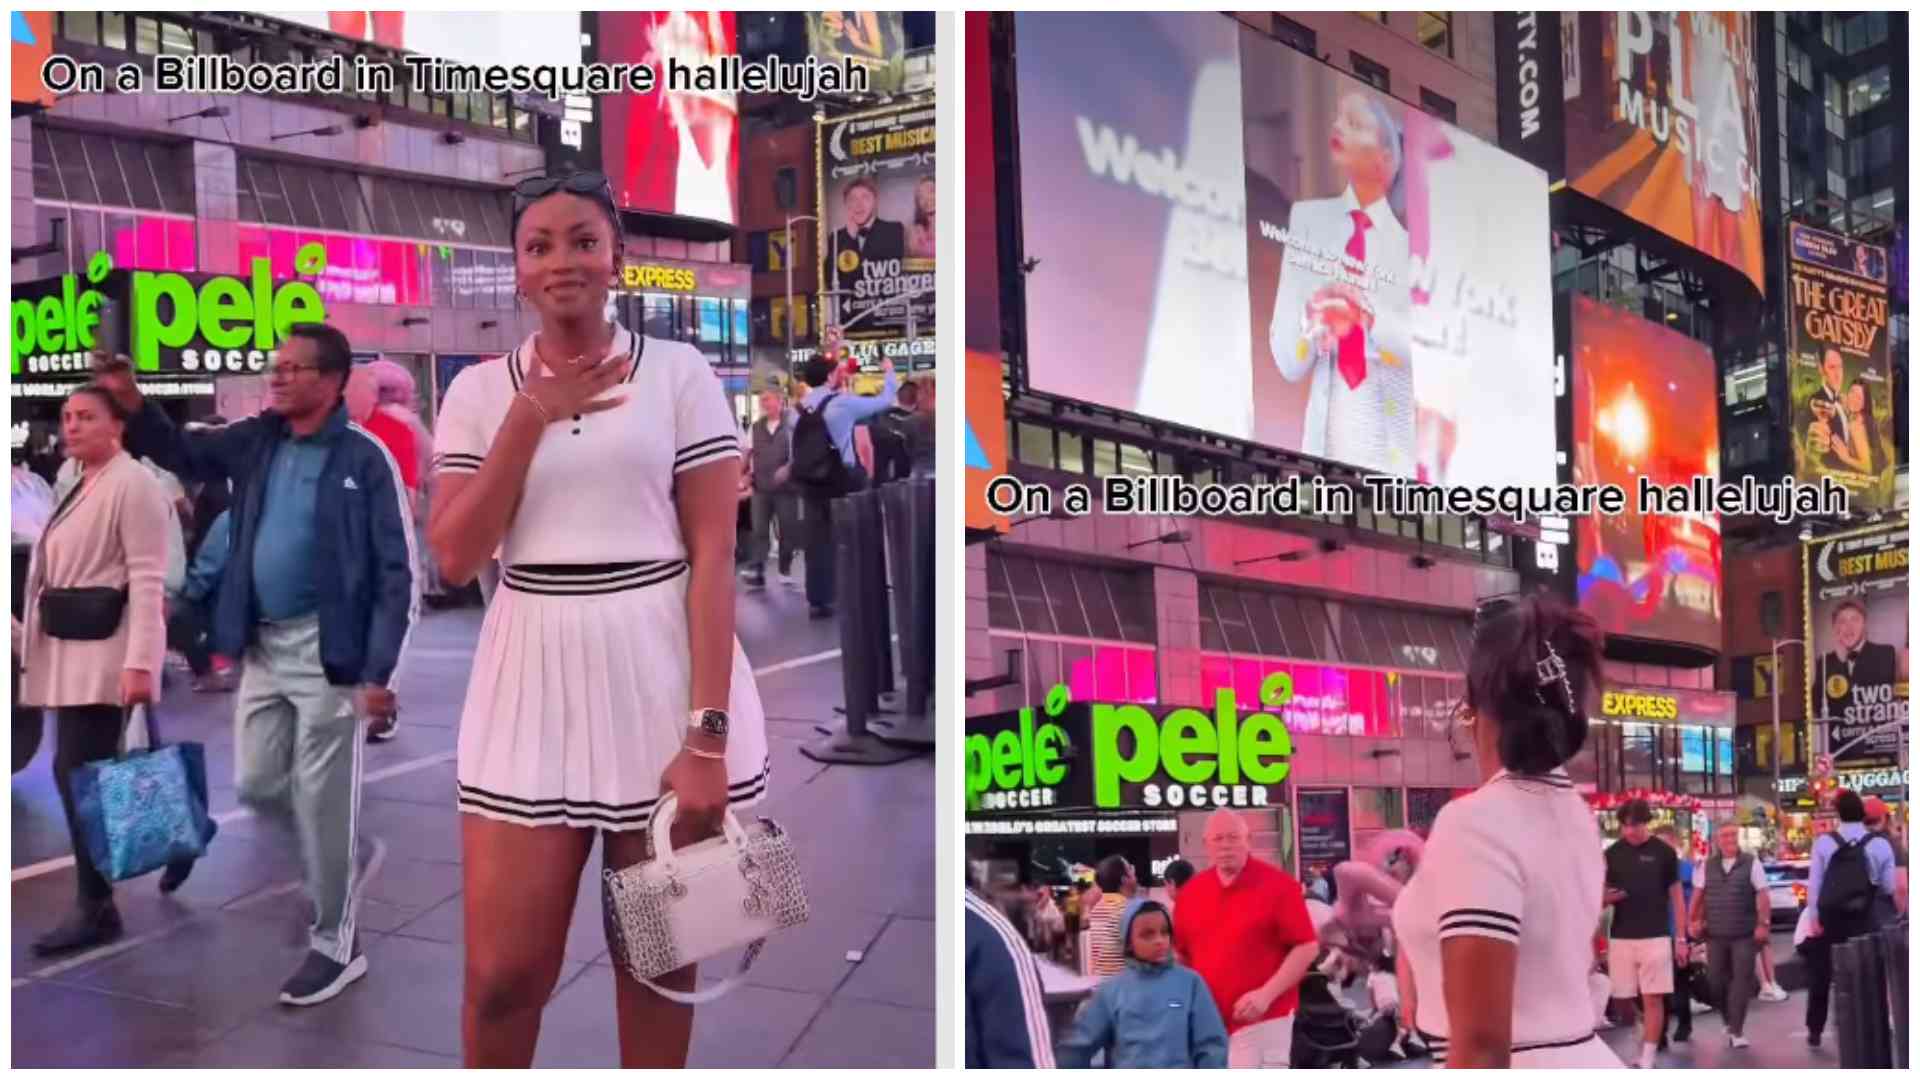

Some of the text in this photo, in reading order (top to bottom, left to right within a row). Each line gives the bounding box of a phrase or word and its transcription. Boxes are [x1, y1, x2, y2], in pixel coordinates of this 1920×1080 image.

[624, 265, 696, 290] EXPRESS
[862, 258, 901, 279] two
[133, 241, 328, 372] pelé
[1792, 274, 1826, 311] THE
[1829, 286, 1887, 327] GREAT
[1805, 309, 1878, 351] GATSBY
[181, 349, 277, 371] SOCC
[1839, 553, 1874, 577] BEST
[1602, 691, 1678, 719] EXPRESS
[1852, 683, 1893, 705] two
[1091, 671, 1293, 807] pelé
[1143, 783, 1268, 807] SOCCER
